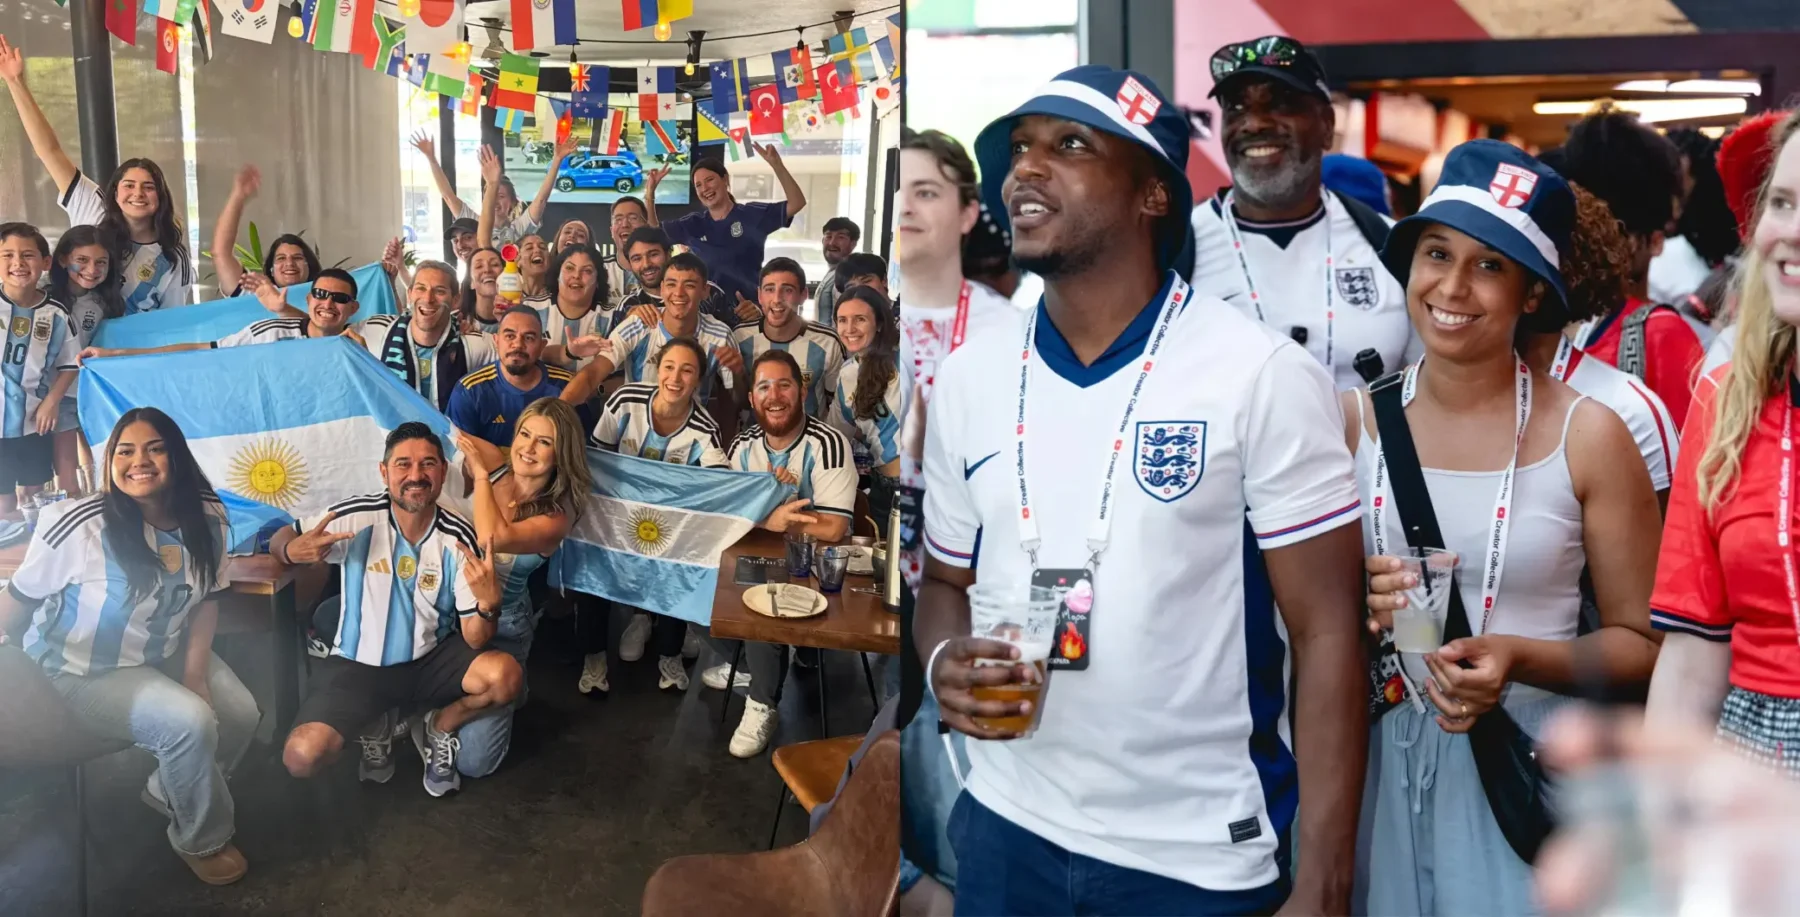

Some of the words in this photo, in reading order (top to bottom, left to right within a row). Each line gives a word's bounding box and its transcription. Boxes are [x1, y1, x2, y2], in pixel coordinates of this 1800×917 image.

[1164, 302, 1177, 324] Creator
[1150, 325, 1168, 355] Collective
[1019, 364, 1027, 397] Collective
[1133, 372, 1147, 397] Creator
[1520, 378, 1528, 407] Collective
[1120, 398, 1136, 433] Collective
[1106, 452, 1118, 480] Creator
[1020, 478, 1028, 506] Creator
[1100, 482, 1112, 520] Collective
[1493, 520, 1503, 550] Creator
[1487, 550, 1499, 590] Collective
